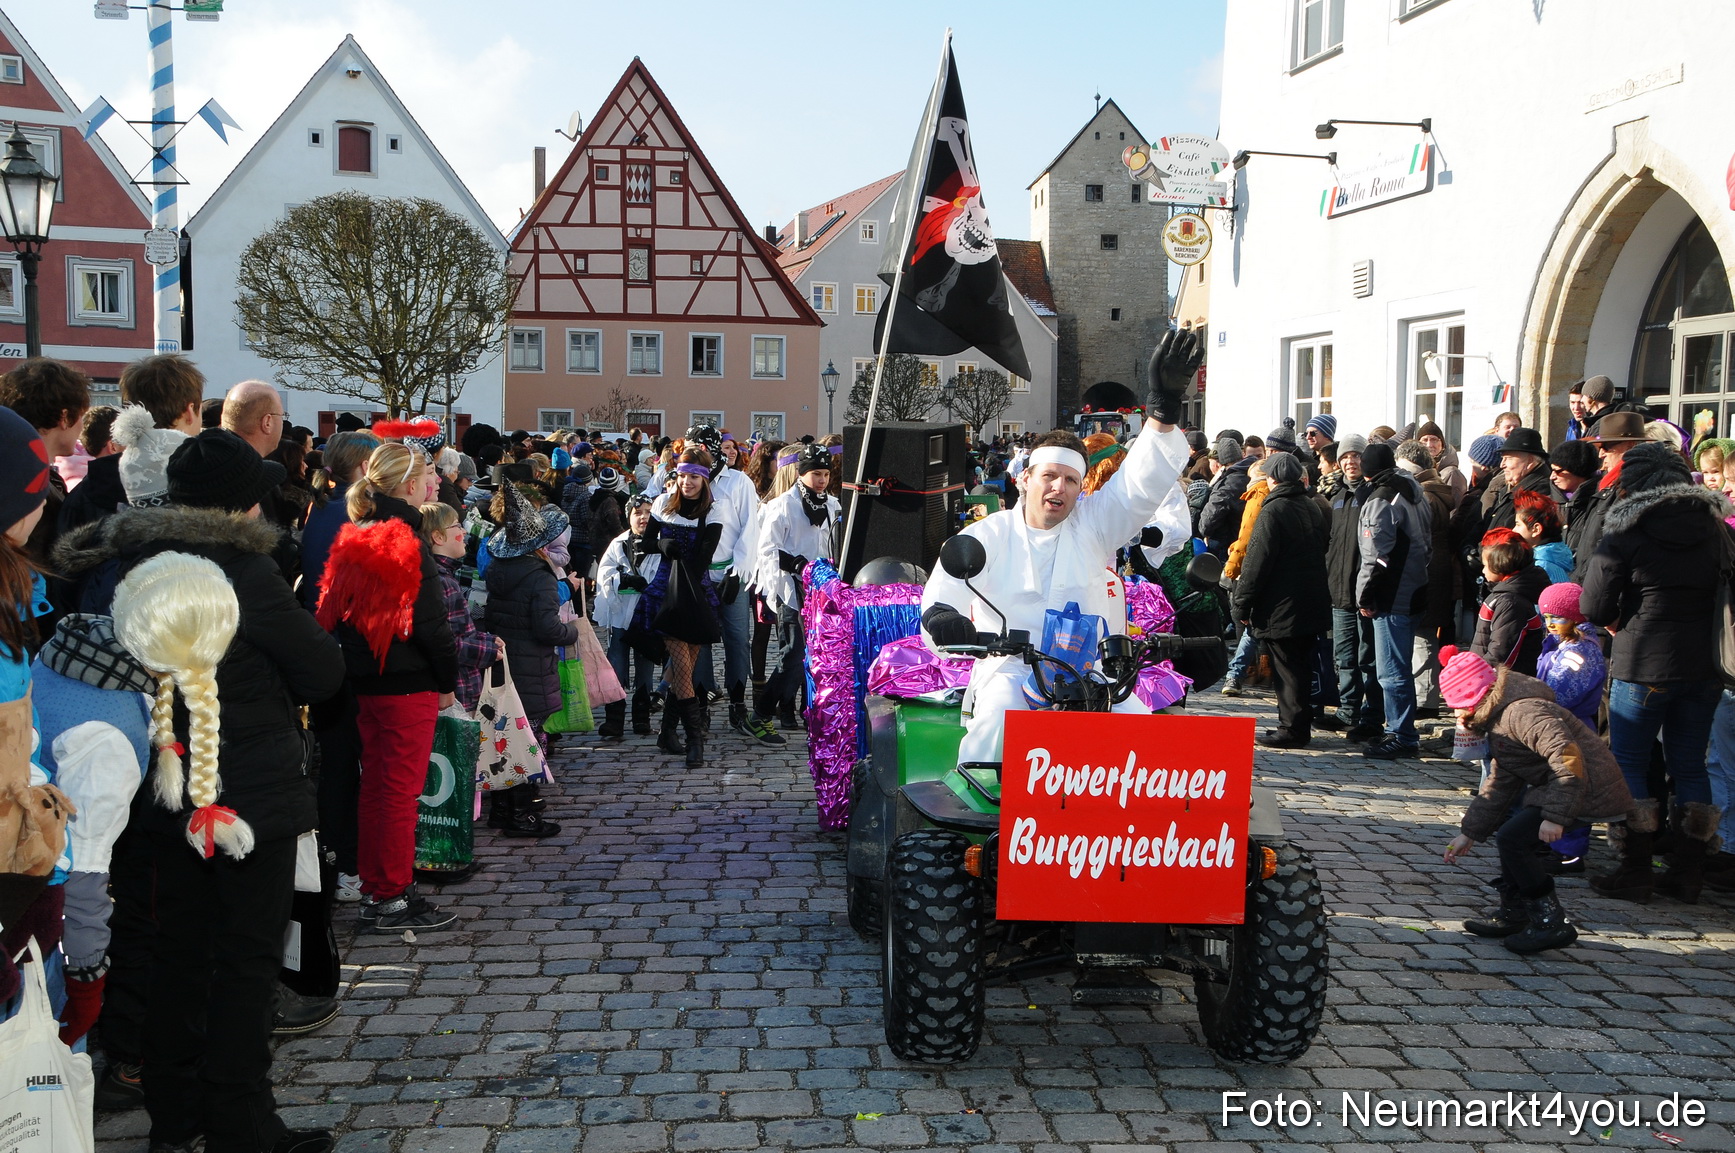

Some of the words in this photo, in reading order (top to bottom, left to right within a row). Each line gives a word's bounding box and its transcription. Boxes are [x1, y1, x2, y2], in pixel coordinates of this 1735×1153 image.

[1169, 136, 1210, 148] Pizzeria
[1178, 151, 1200, 162] Café
[1166, 163, 1210, 177] Eisdiele
[1173, 186, 1204, 195] Bella
[1370, 176, 1406, 199] Roma
[1152, 191, 1186, 200] Roma
[1025, 747, 1228, 809] Powerfrauen
[417, 813, 460, 828] HMANN
[1008, 816, 1236, 880] Burggriesbach
